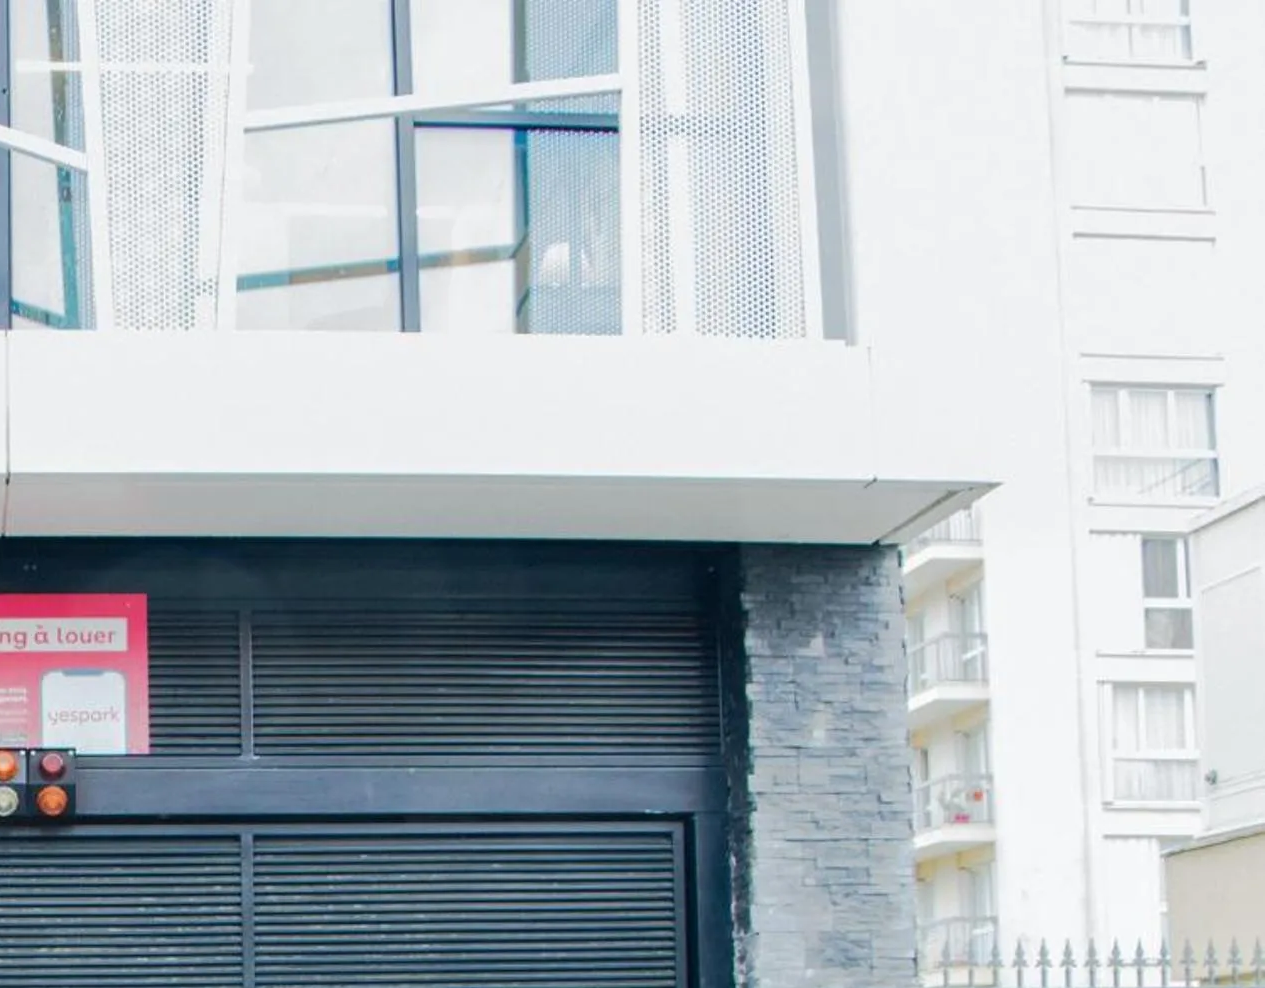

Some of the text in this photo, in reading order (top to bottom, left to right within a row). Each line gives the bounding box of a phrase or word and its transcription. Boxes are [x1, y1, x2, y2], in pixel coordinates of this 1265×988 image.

[35, 625, 49, 645] à
[57, 626, 116, 645] louer
[47, 706, 121, 726] yespark
